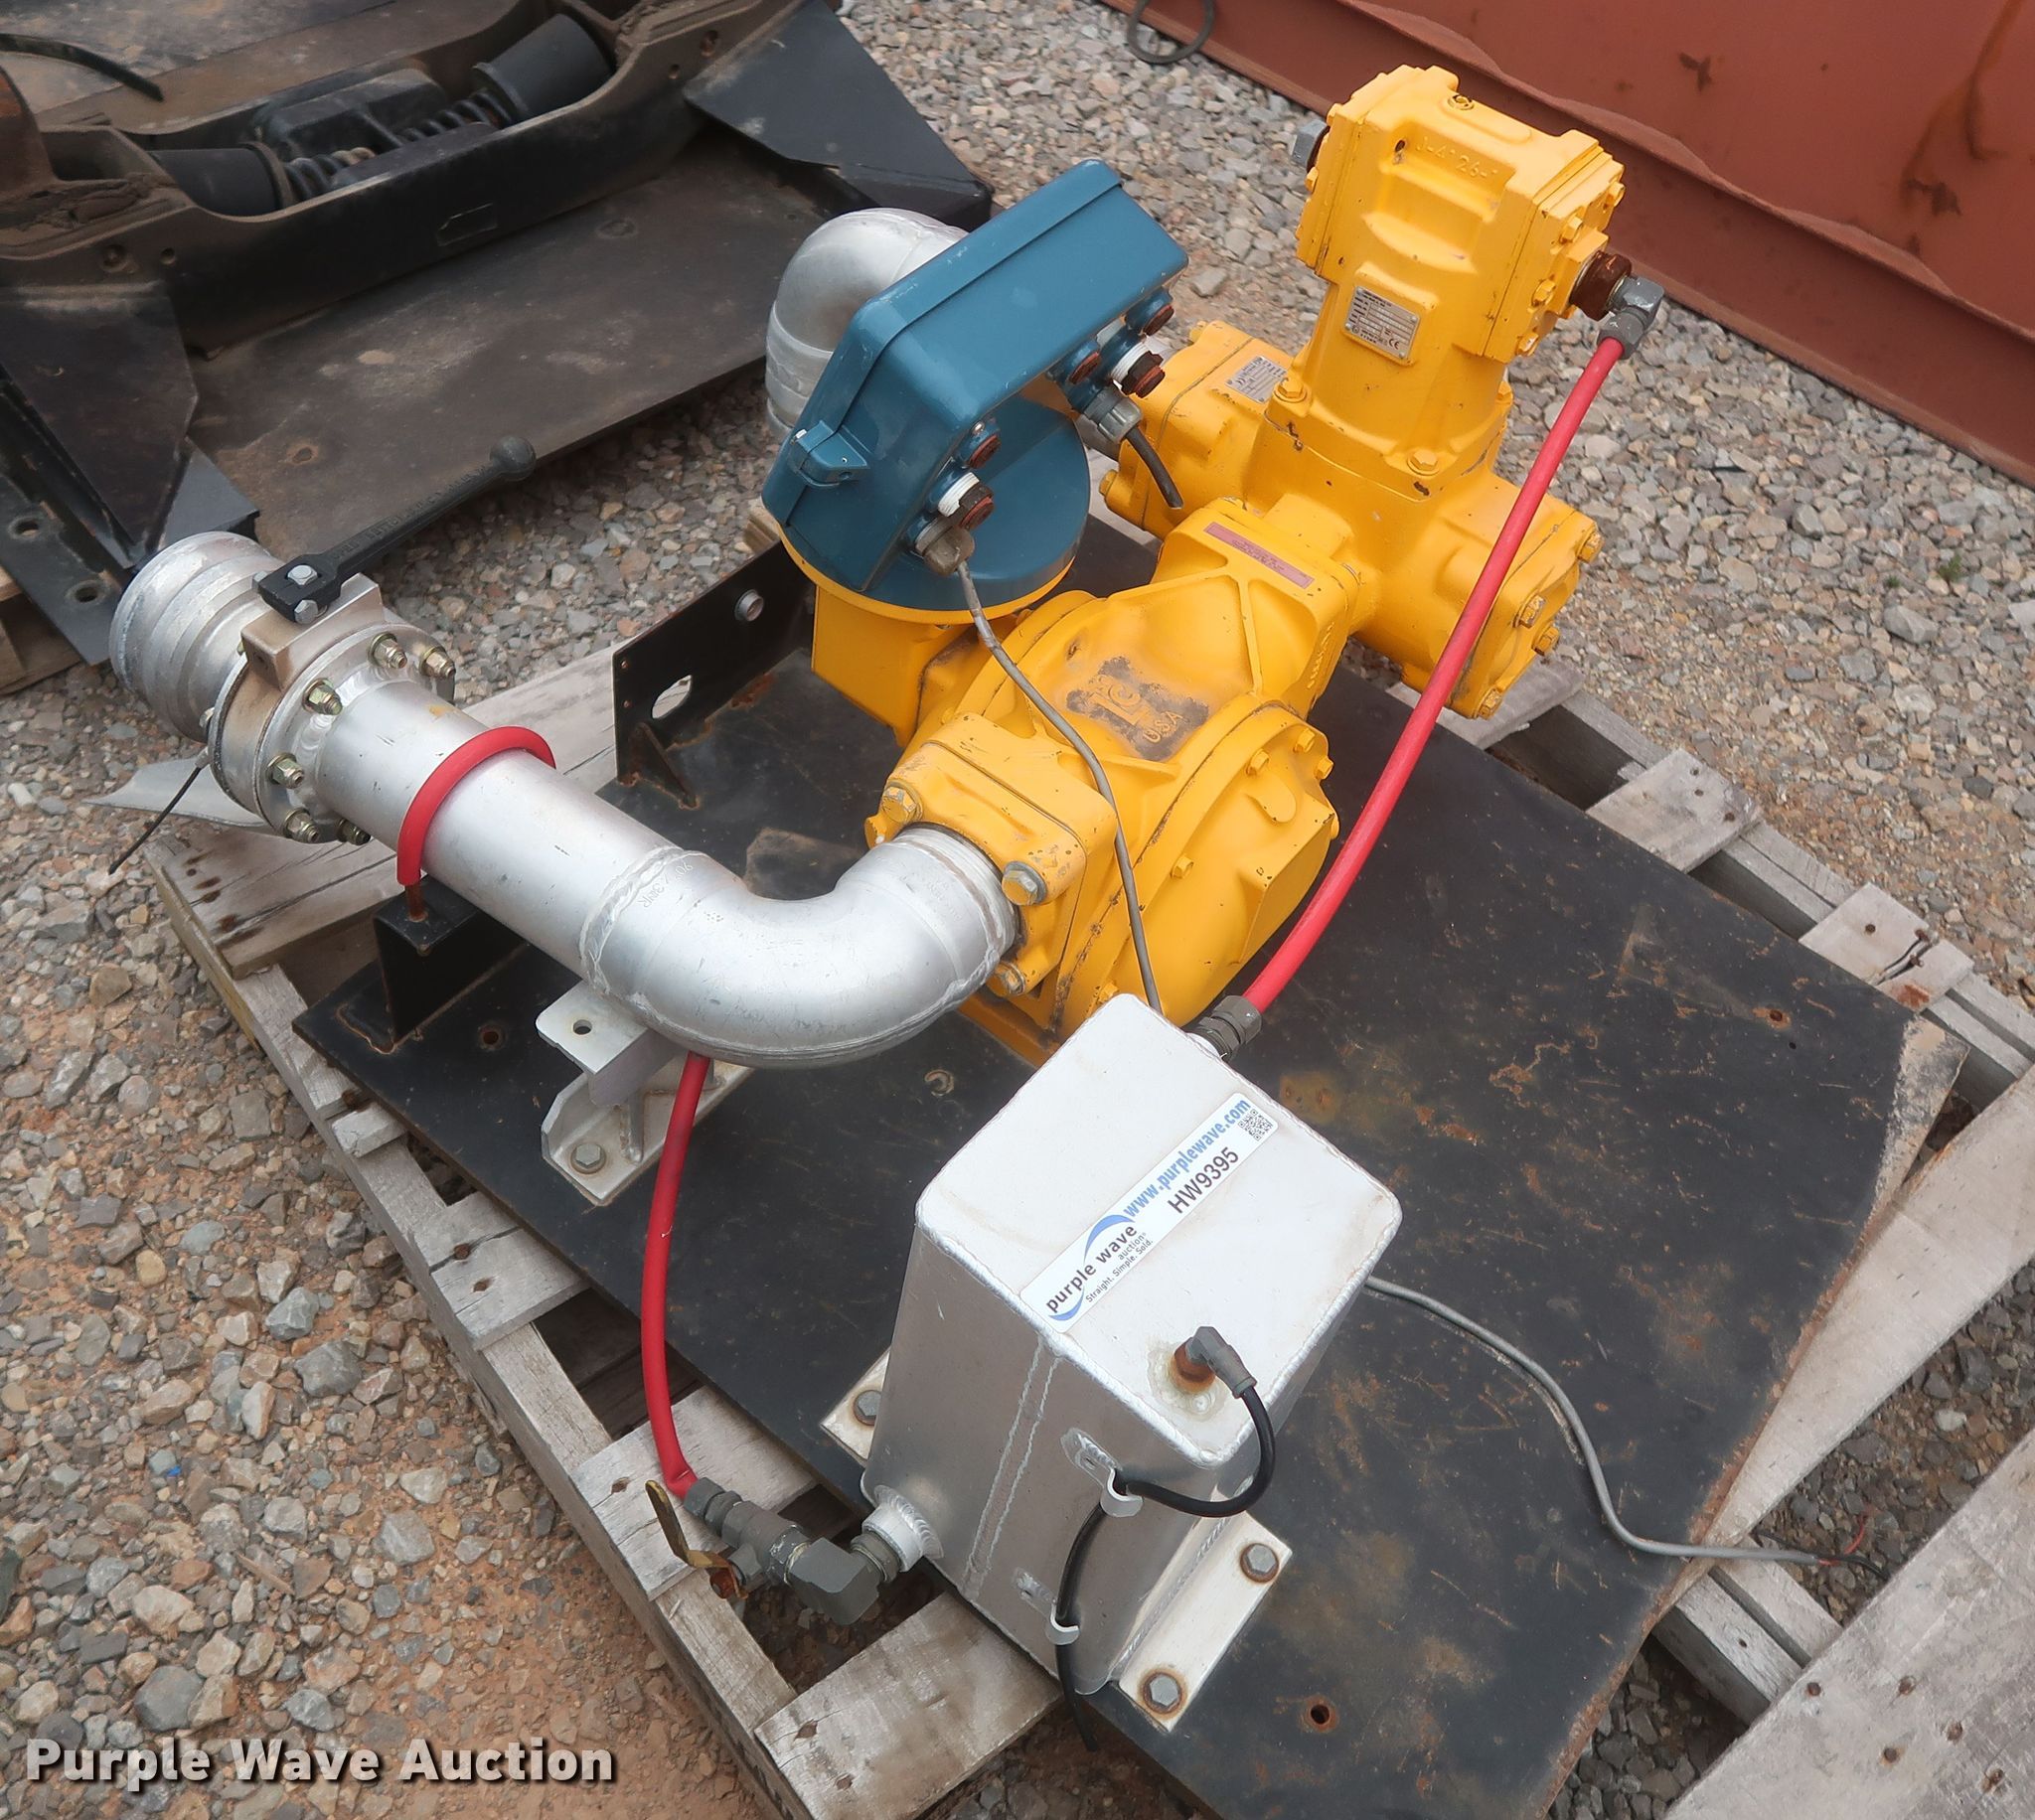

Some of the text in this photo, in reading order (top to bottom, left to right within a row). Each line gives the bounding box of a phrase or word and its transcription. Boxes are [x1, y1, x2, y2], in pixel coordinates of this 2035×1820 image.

[1143, 710, 1183, 743] USA
[1123, 1099, 1252, 1218] www.purplewave.com
[1167, 1146, 1239, 1214] HW9395
[1045, 1224, 1138, 1313] purple wave
[1085, 1238, 1154, 1303] Straight. Simple. Sold.
